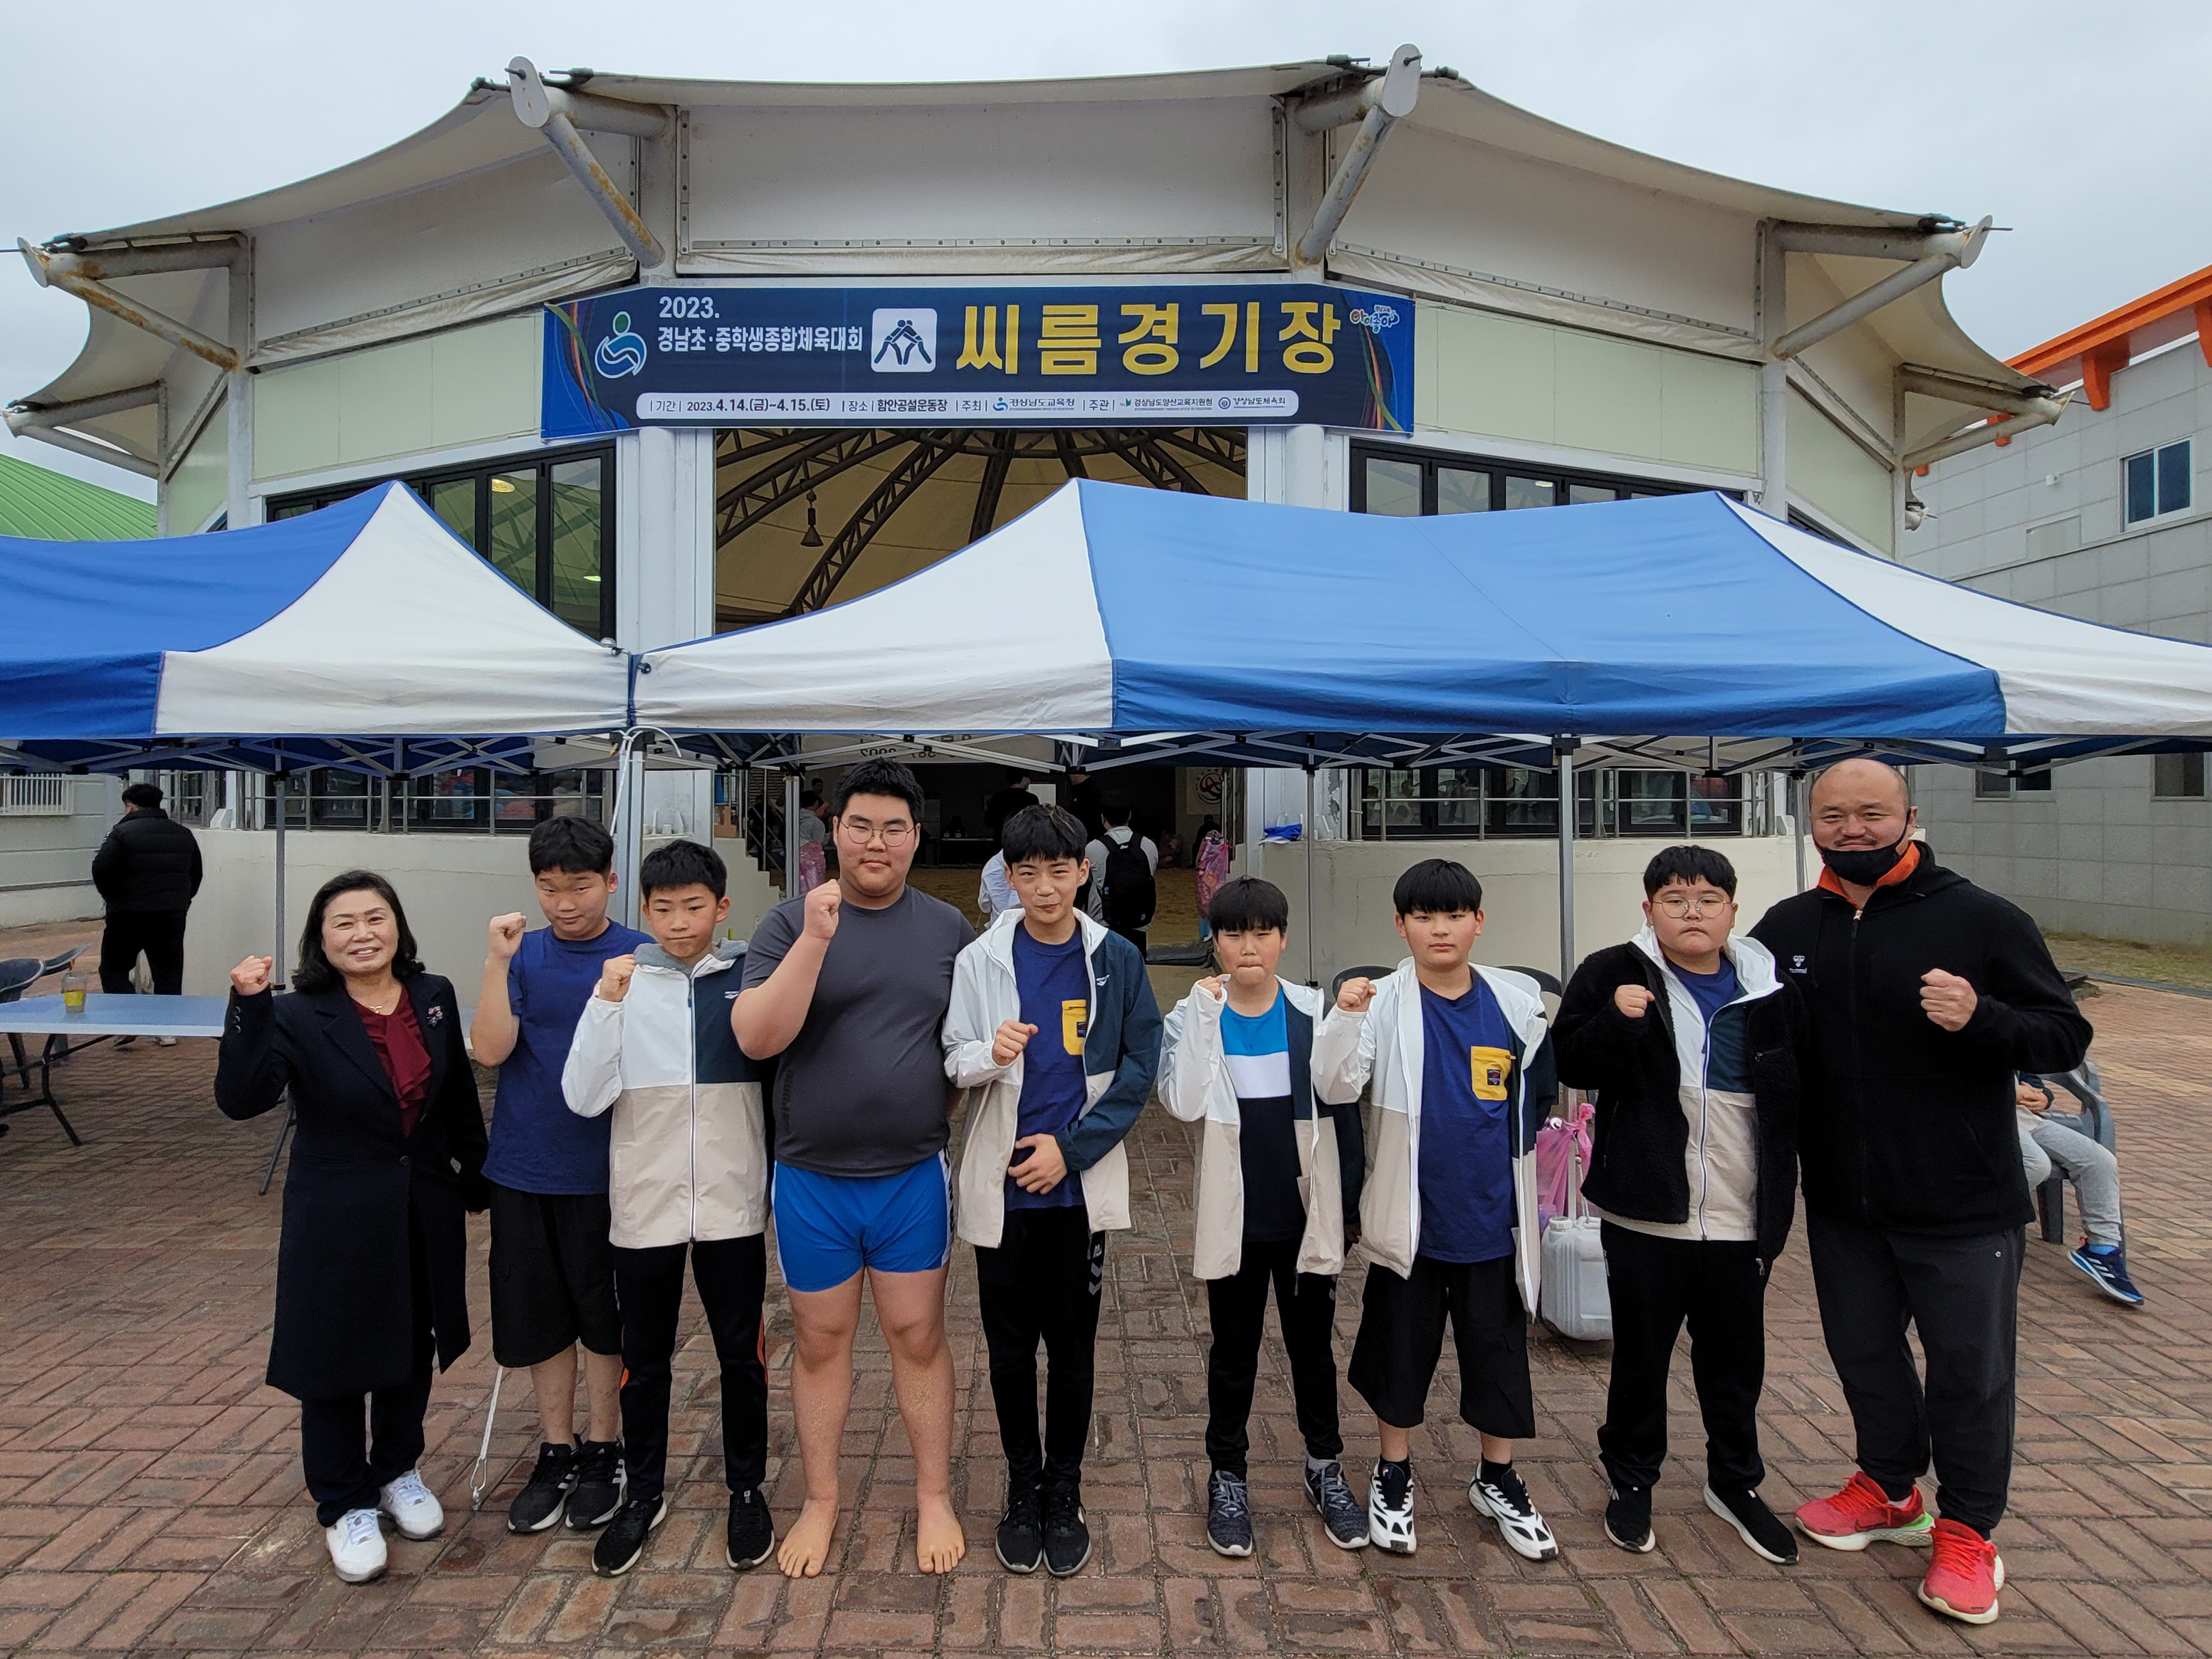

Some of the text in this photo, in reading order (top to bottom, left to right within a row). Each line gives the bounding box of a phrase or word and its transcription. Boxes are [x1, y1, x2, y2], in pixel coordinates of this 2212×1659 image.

[659, 296, 720, 318] 2023.
[658, 326, 863, 352] 경남초·중학생종합체육대회
[956, 302, 1341, 375] 씨름경기장
[655, 400, 676, 412] 기간
[848, 400, 869, 412] 장소
[877, 399, 948, 412] 함안공설운동장
[961, 399, 982, 412] 주최
[1089, 399, 1109, 412] 주관
